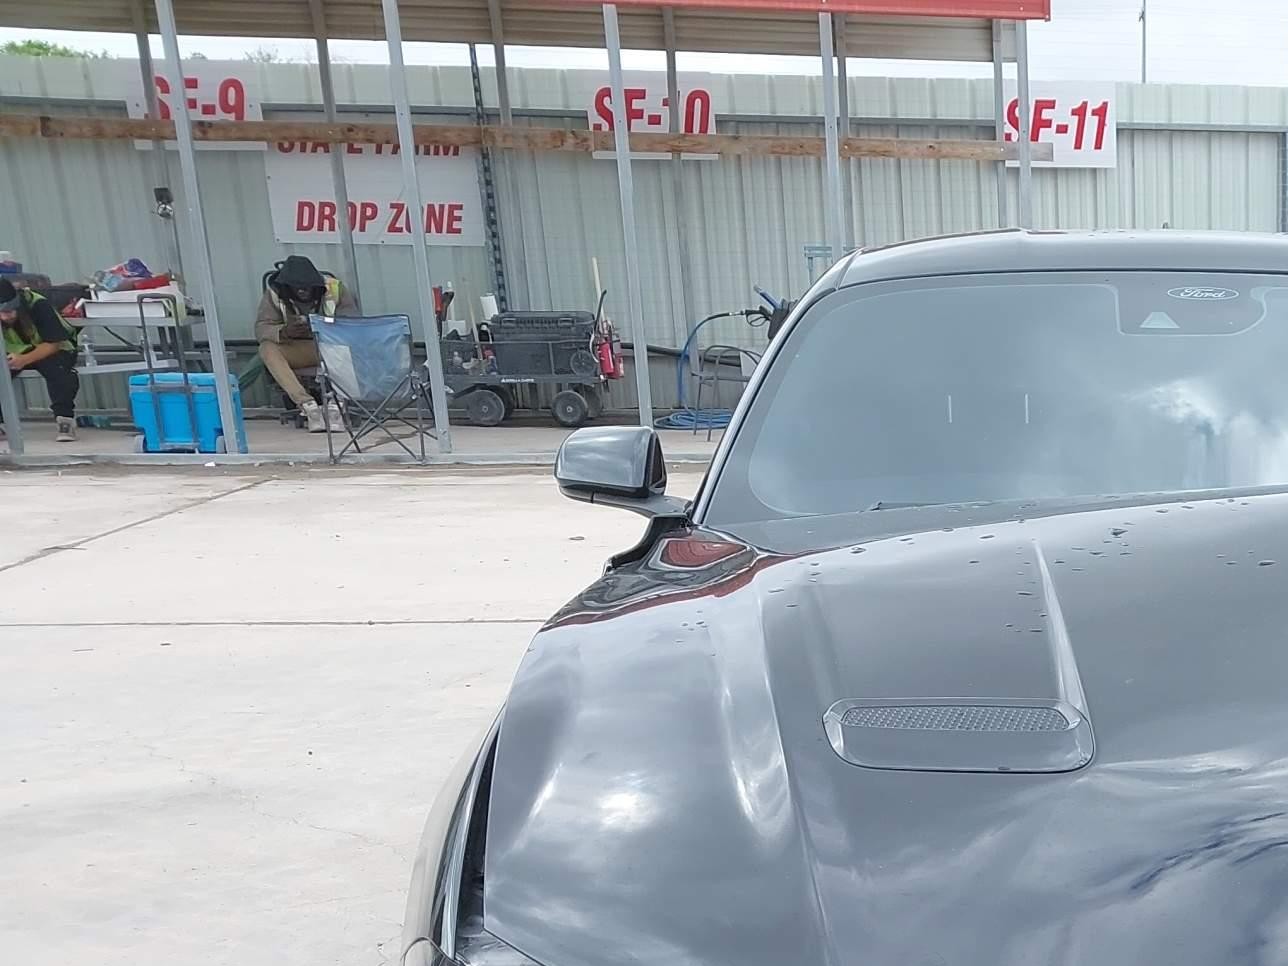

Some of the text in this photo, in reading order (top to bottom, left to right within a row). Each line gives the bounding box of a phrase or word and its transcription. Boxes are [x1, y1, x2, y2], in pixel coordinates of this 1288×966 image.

[593, 87, 711, 134] SF-0
[1004, 98, 1109, 150] SF-11
[1178, 287, 1228, 299] Ford
